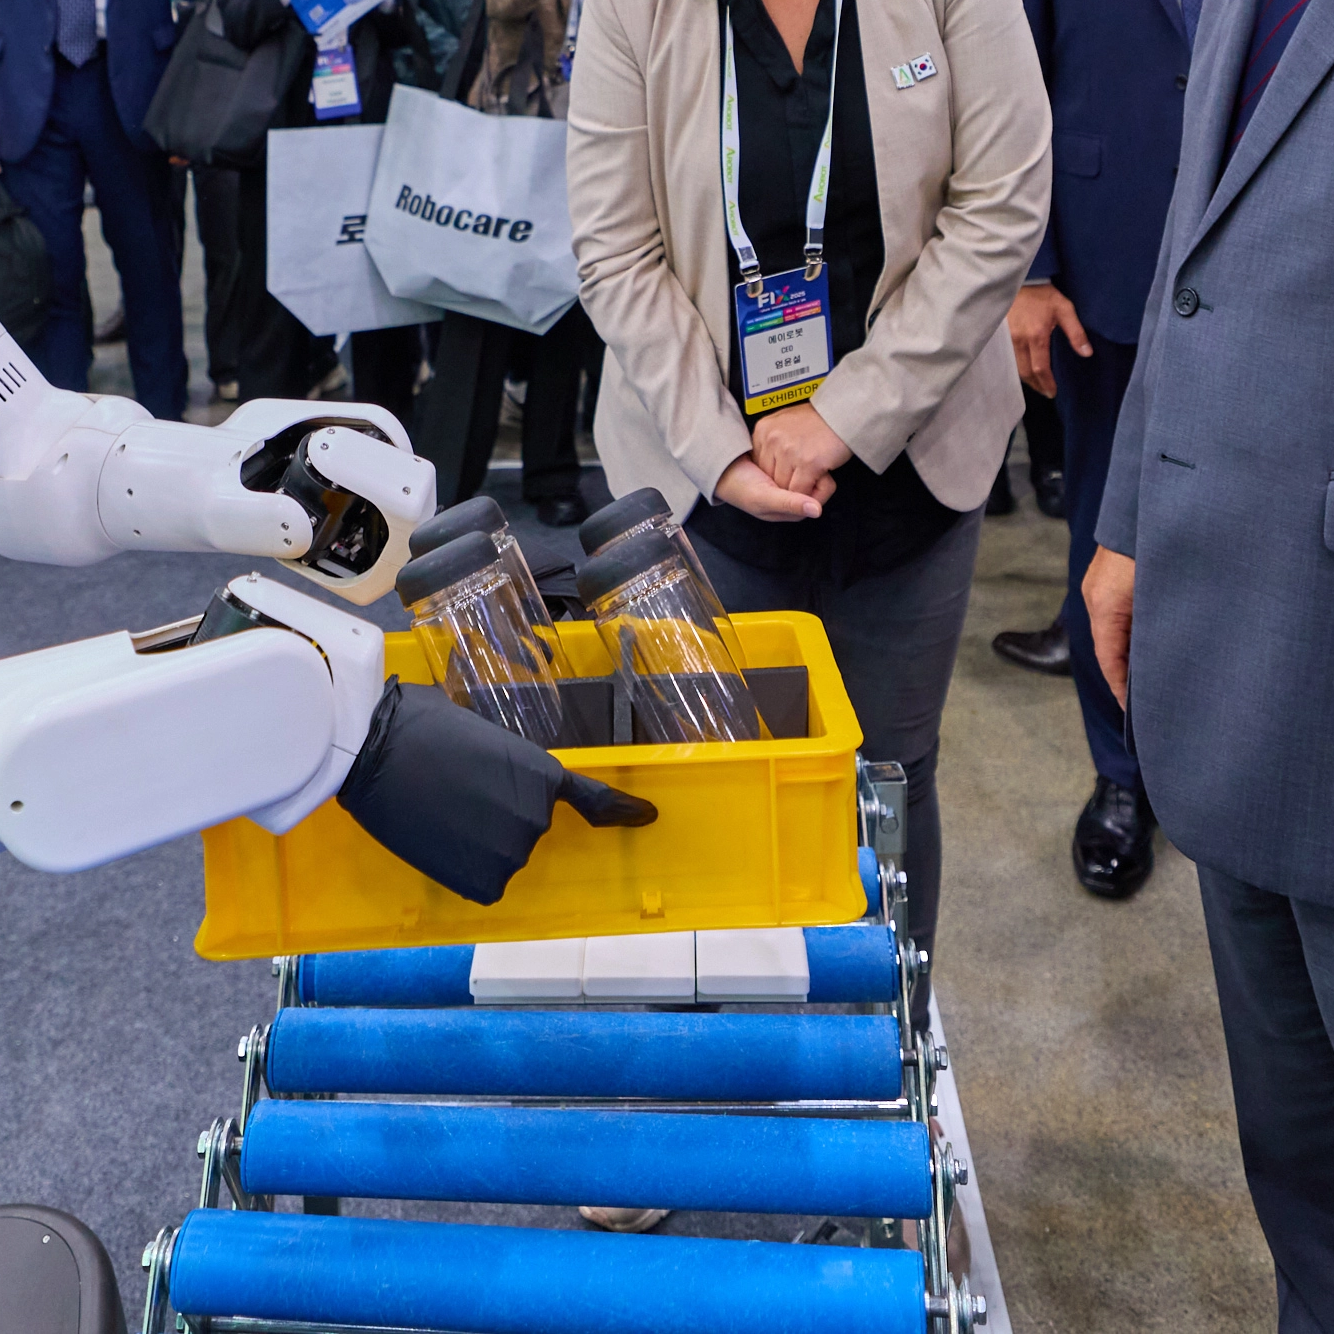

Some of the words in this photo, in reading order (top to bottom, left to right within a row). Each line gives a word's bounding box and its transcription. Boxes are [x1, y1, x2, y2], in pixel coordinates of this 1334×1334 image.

[395, 183, 534, 243] Robocare
[757, 285, 790, 308] FIX
[768, 327, 804, 345] 에이로봇
[761, 383, 819, 408] EXHIBITOR
